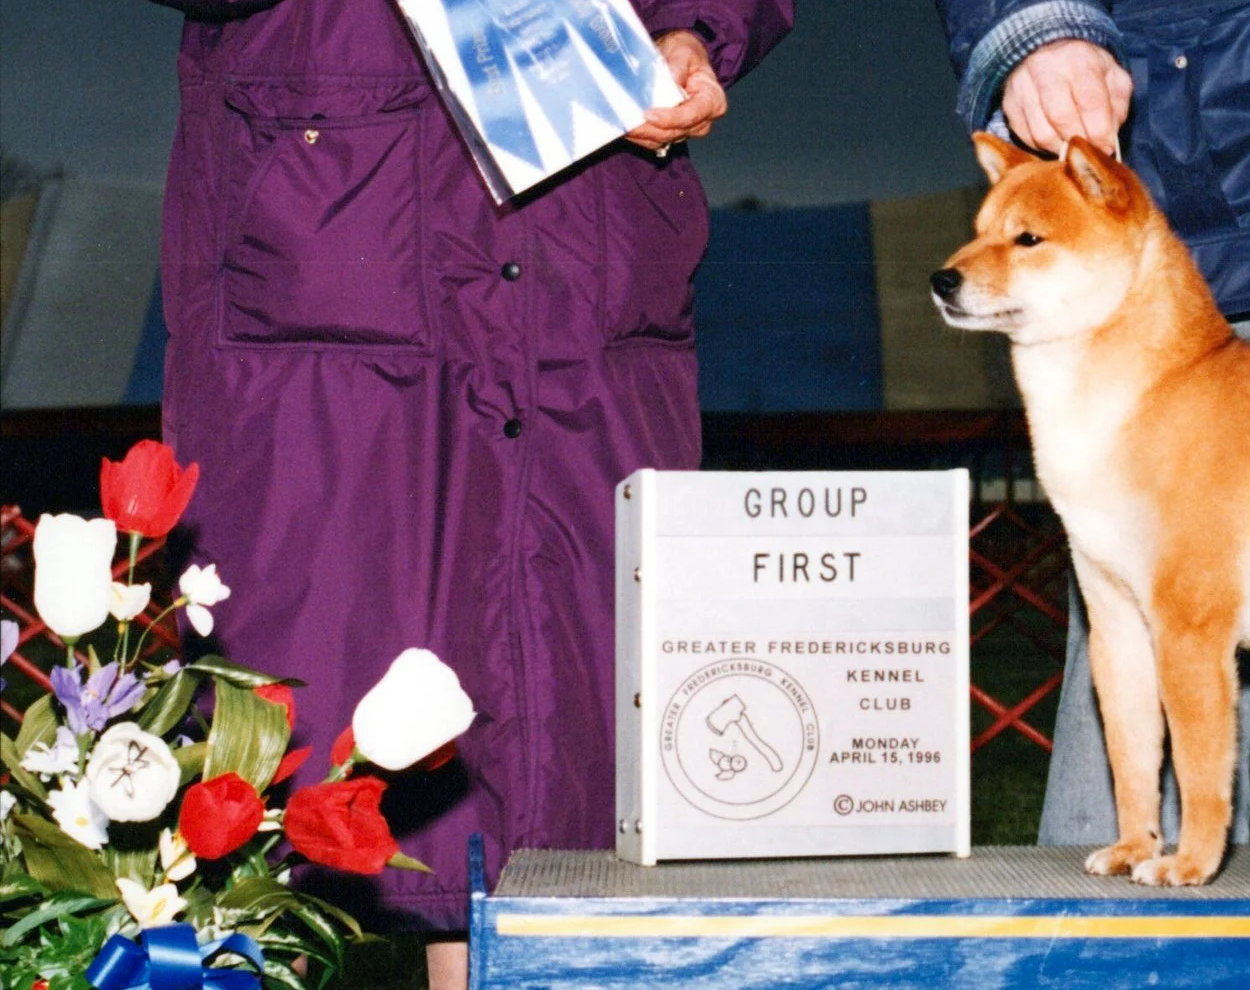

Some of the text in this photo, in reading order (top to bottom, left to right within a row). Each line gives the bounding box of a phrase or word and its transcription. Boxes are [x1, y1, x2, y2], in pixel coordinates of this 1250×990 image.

[743, 487, 868, 519] GROUP
[753, 551, 862, 583] FIRST
[661, 640, 951, 655] GREATER FREDERICKSBURG
[846, 669, 925, 684] KENNEL
[664, 662, 816, 752] GREATER FREDERICKSBURG KENNEL CLUB
[858, 697, 912, 711] CLUB
[851, 737, 919, 750] MONDAY
[829, 751, 941, 766] APRIL 15, 1996
[898, 798, 947, 813] ASHBEY
